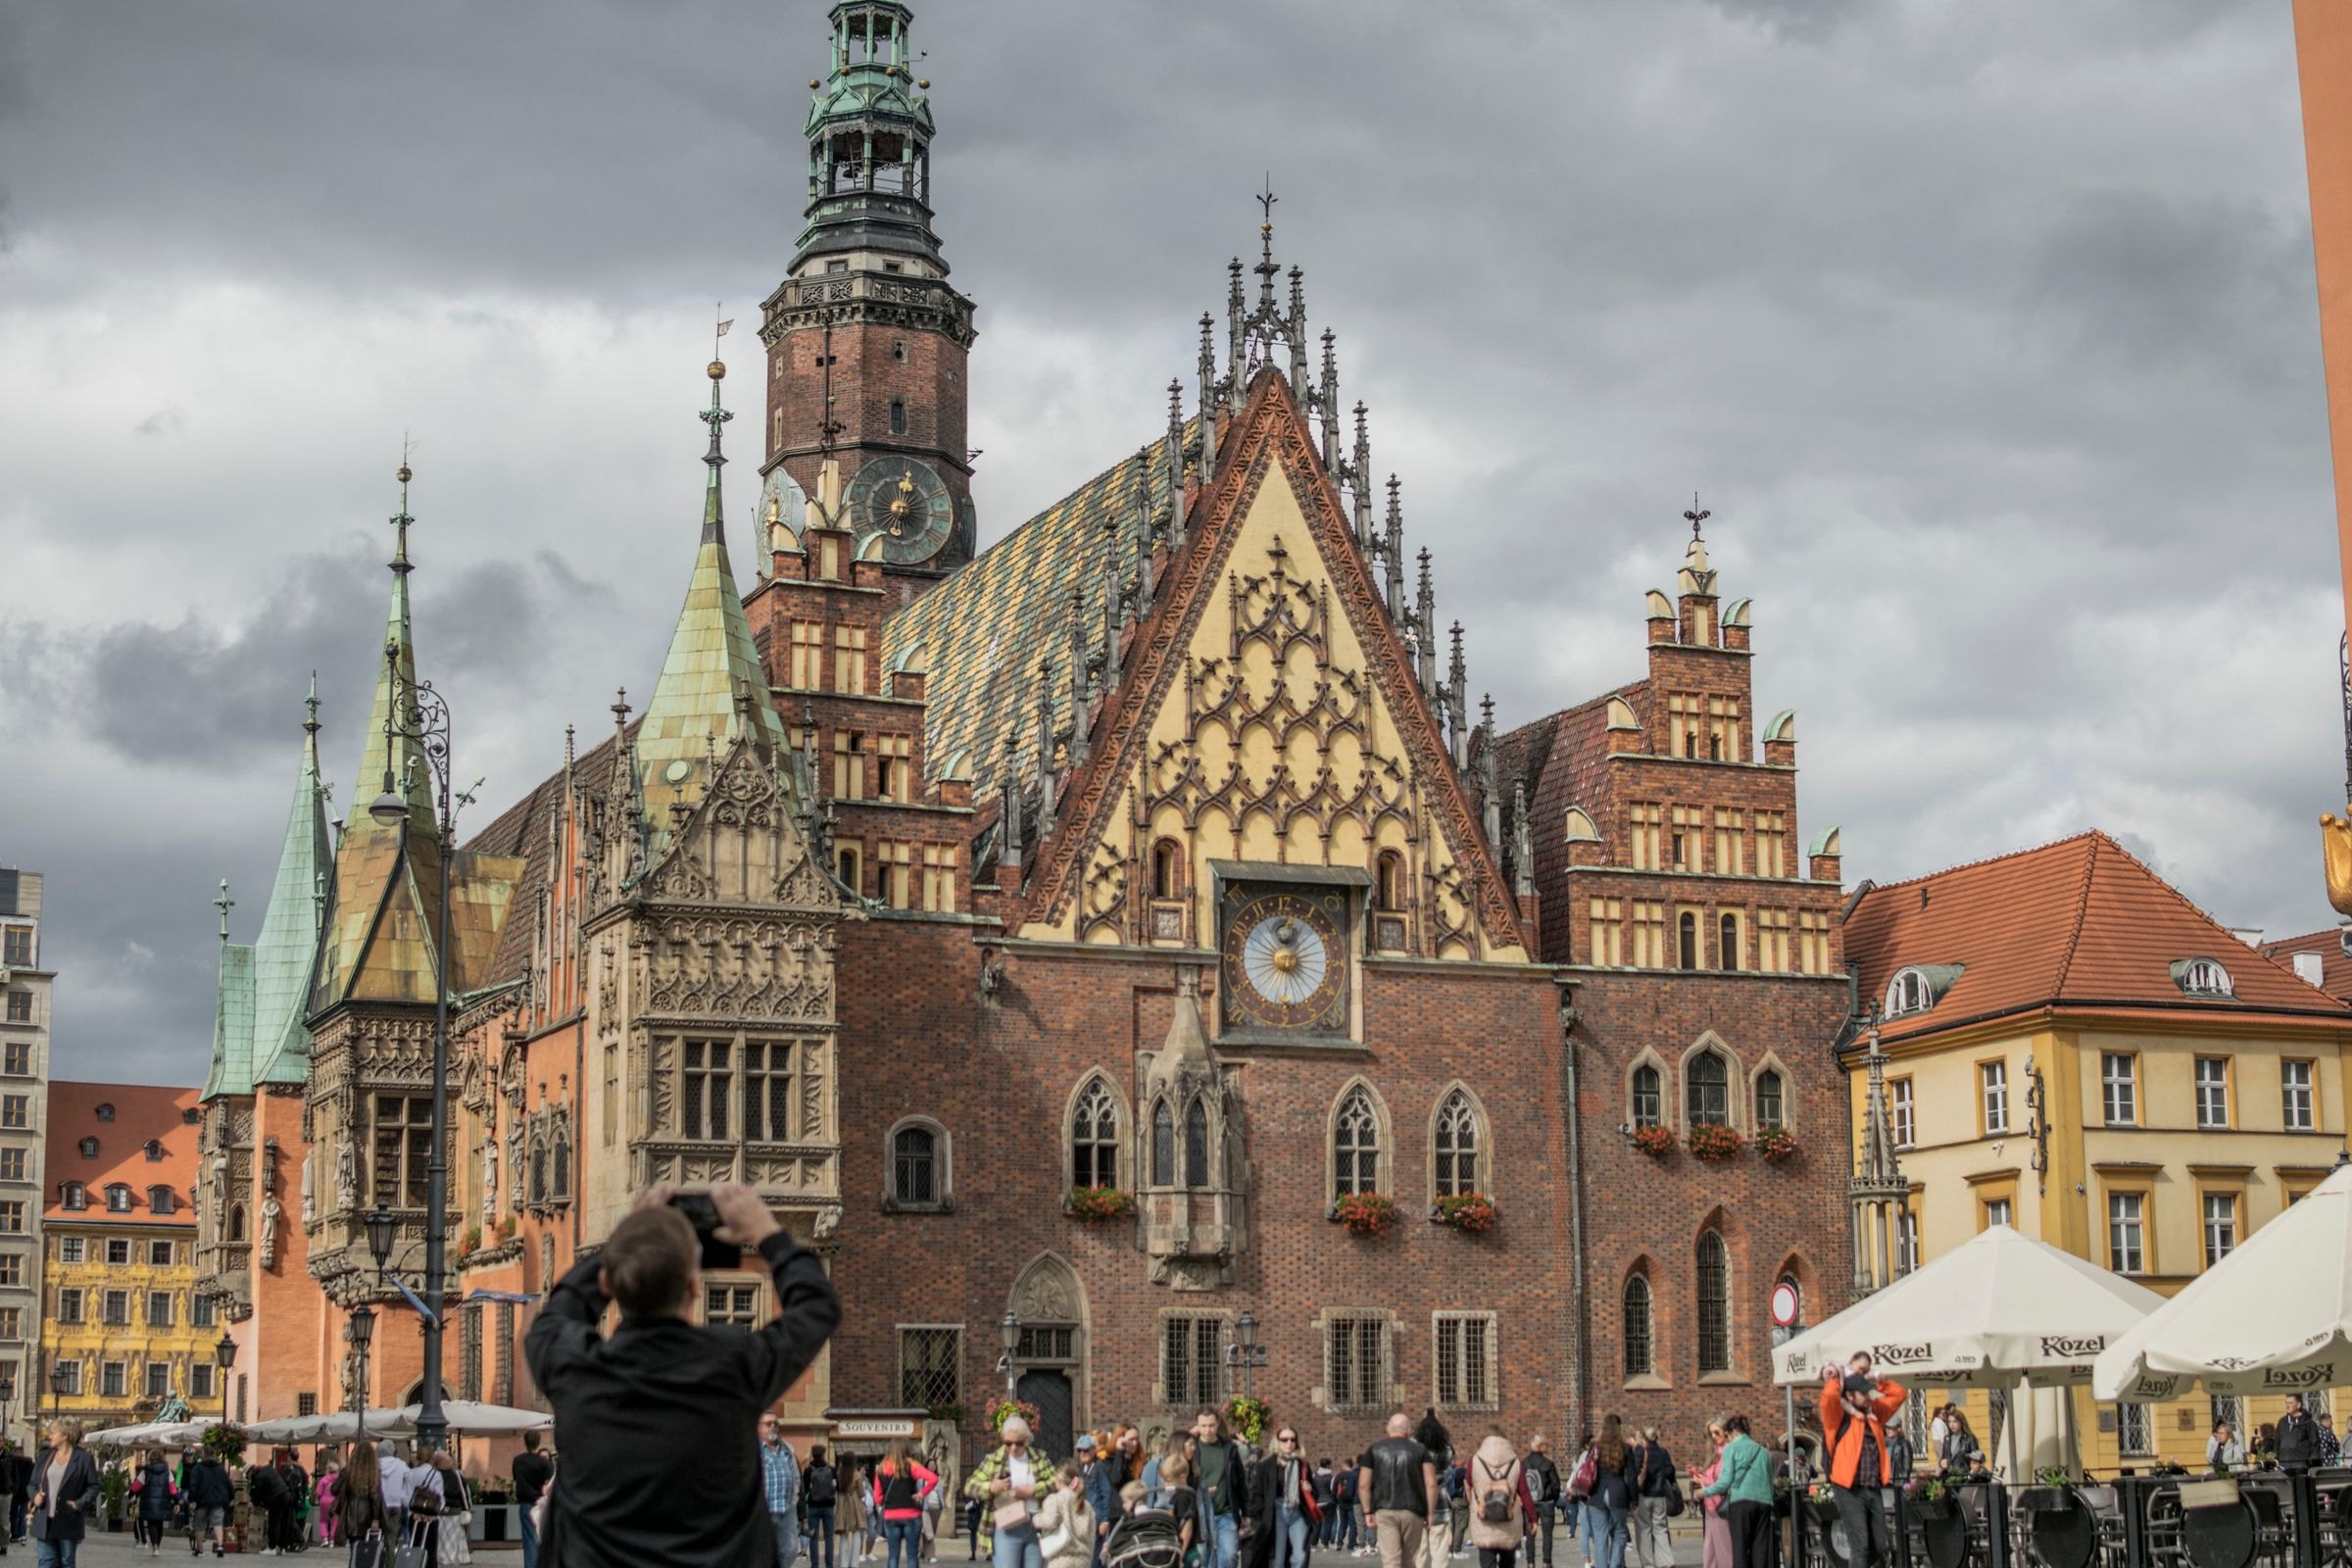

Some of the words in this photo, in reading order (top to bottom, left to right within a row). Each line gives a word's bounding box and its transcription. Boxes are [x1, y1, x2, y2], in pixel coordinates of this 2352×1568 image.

[1252, 902, 1264, 917] 11
[1278, 897, 1292, 911] 12
[1308, 906, 1314, 917] 1
[1232, 920, 1247, 936] 10
[1225, 954, 1239, 962] 9
[2040, 1336, 2105, 1357] Kozel
[1872, 1343, 1934, 1366] Kozel
